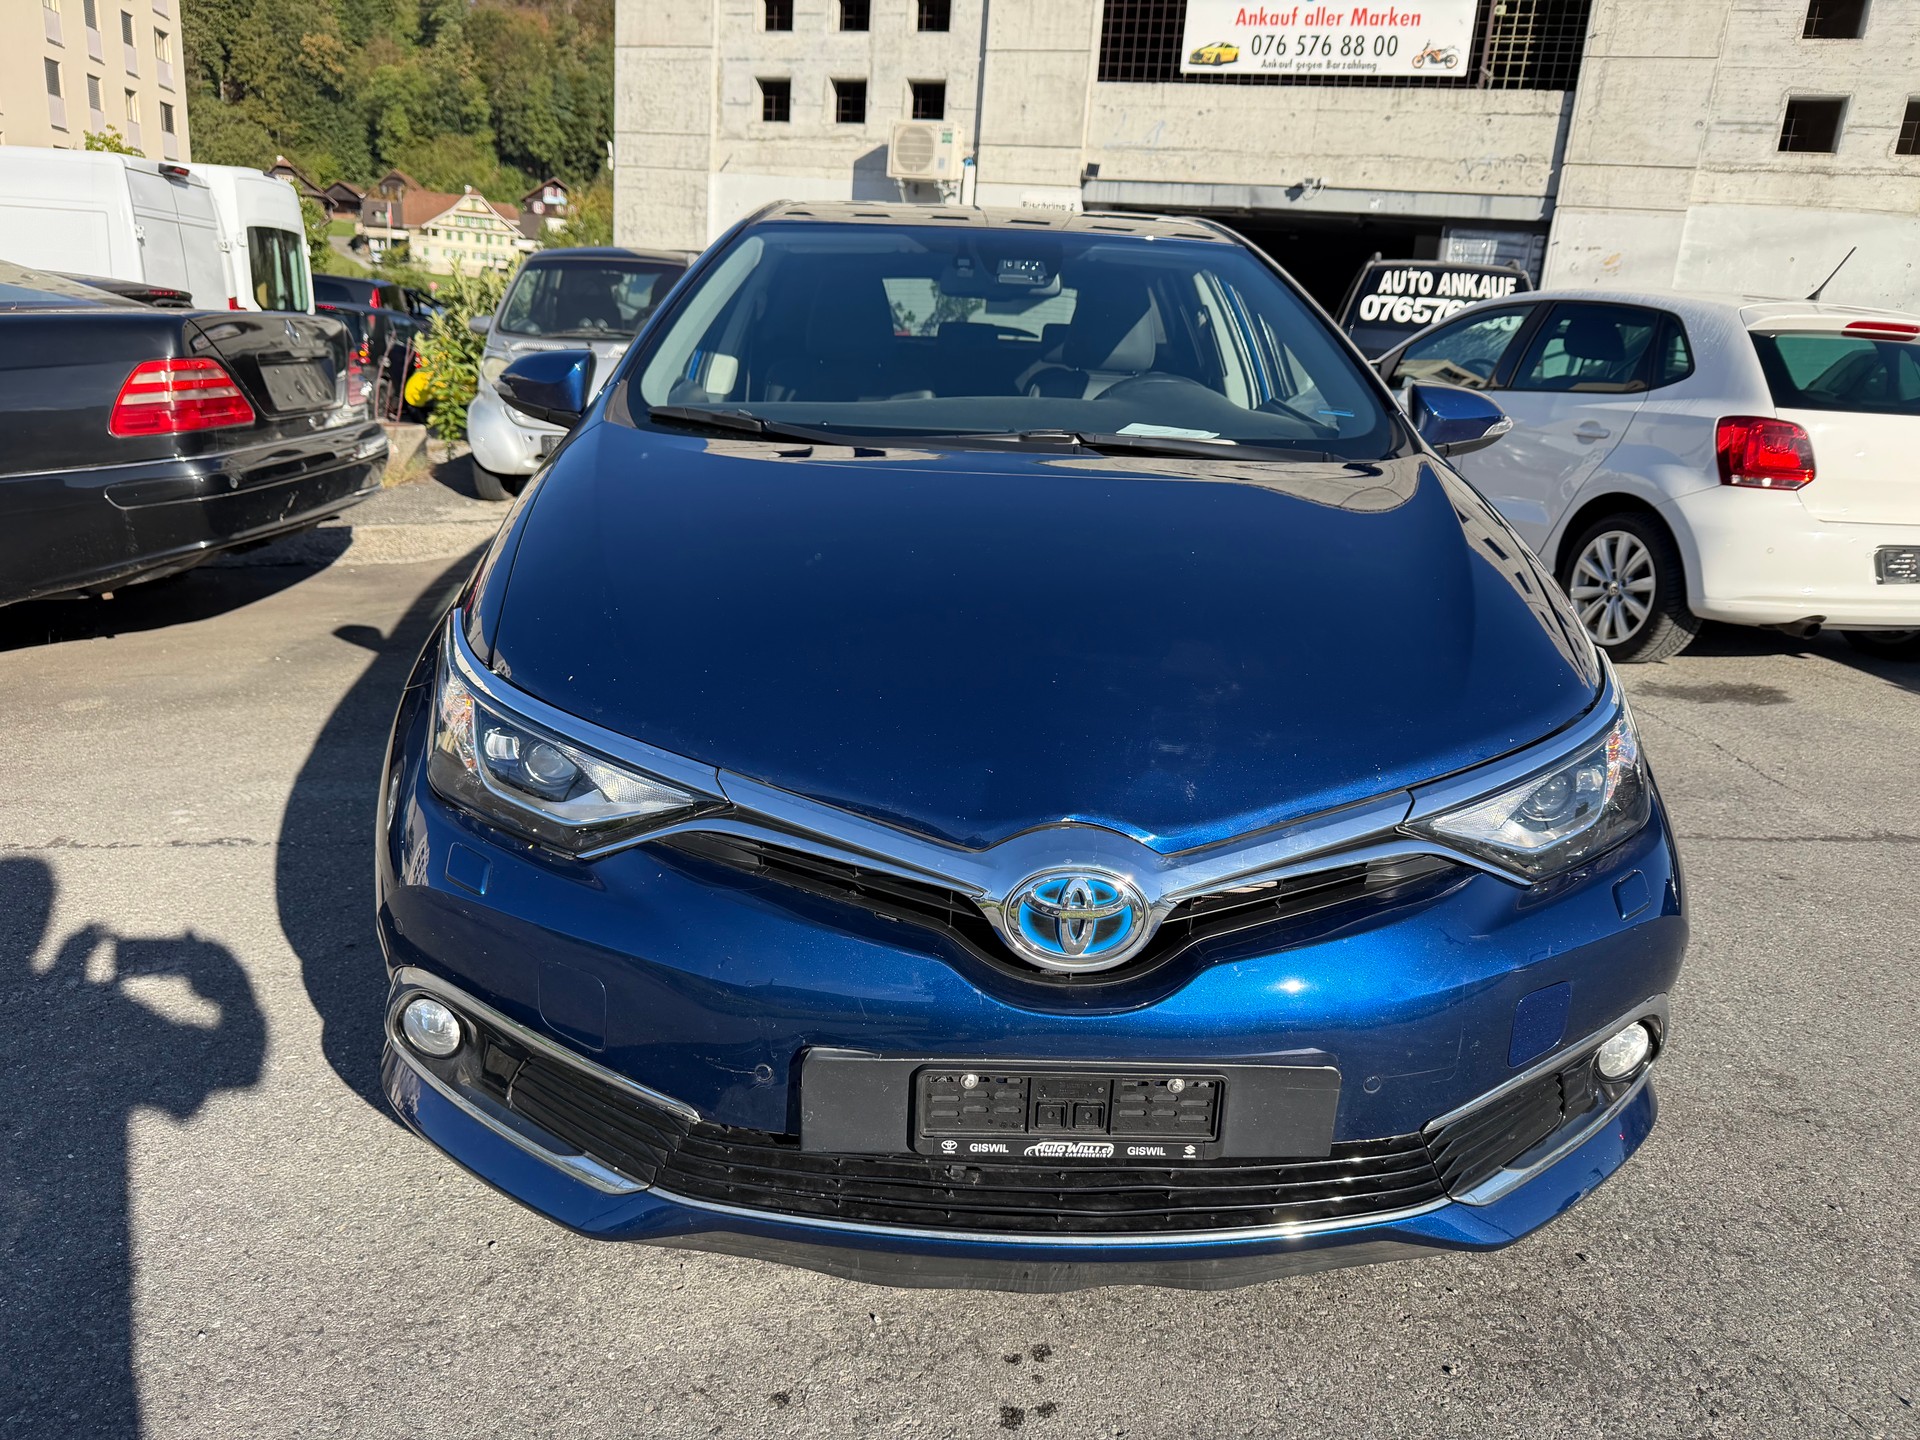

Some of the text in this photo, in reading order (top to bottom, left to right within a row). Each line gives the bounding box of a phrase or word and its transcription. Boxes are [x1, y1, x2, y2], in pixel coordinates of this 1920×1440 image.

[1235, 7, 1422, 26] Ankauf aller Marken
[1251, 35, 1399, 57] 076 576 88 00
[1261, 58, 1378, 73] Ankauf gegen Barzahlung
[1377, 270, 1516, 298] AUTO ANKAUF
[969, 1143, 1009, 1153] GISWIL
[1127, 1146, 1167, 1156] GISWIL
